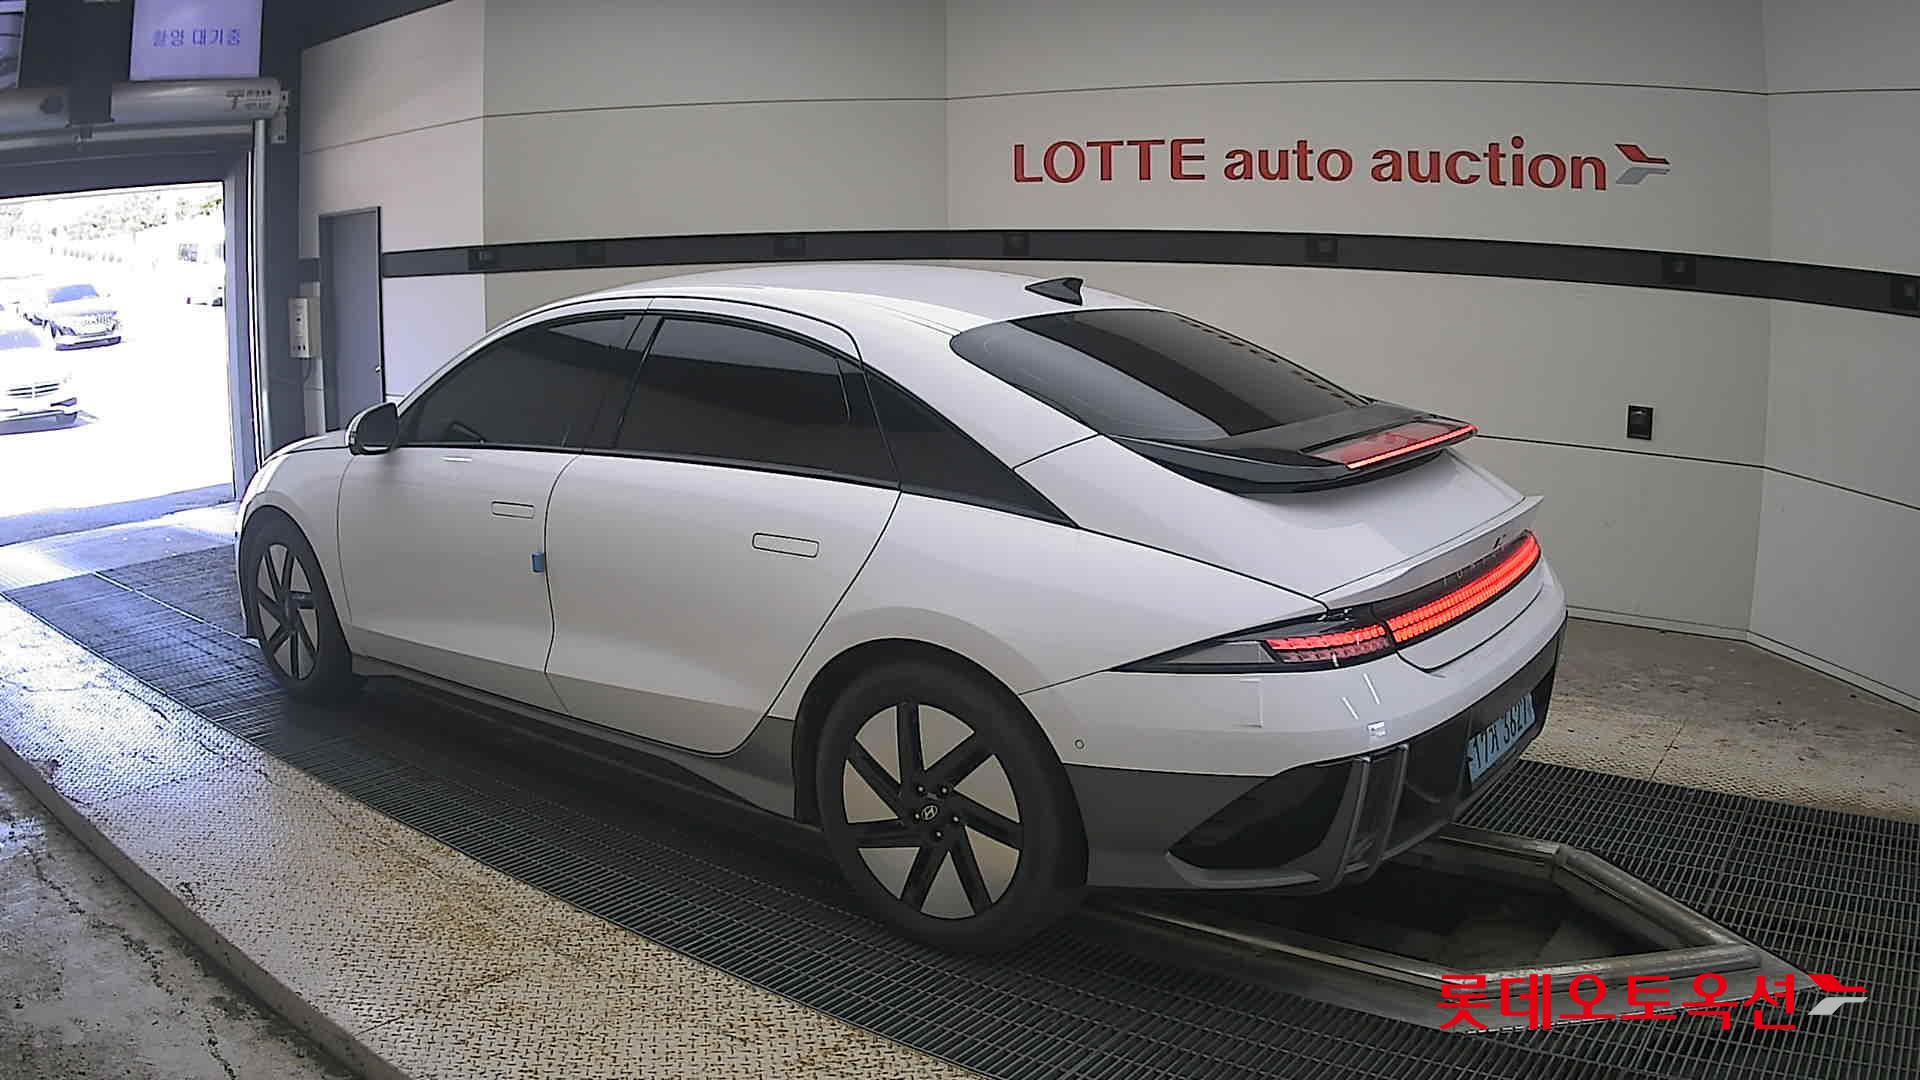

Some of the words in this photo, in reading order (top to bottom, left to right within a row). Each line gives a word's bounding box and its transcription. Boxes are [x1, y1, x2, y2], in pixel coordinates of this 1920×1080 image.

[1013, 138, 1205, 183] LOTTE
[1223, 139, 1353, 181] auto
[1370, 135, 1607, 191] auction
